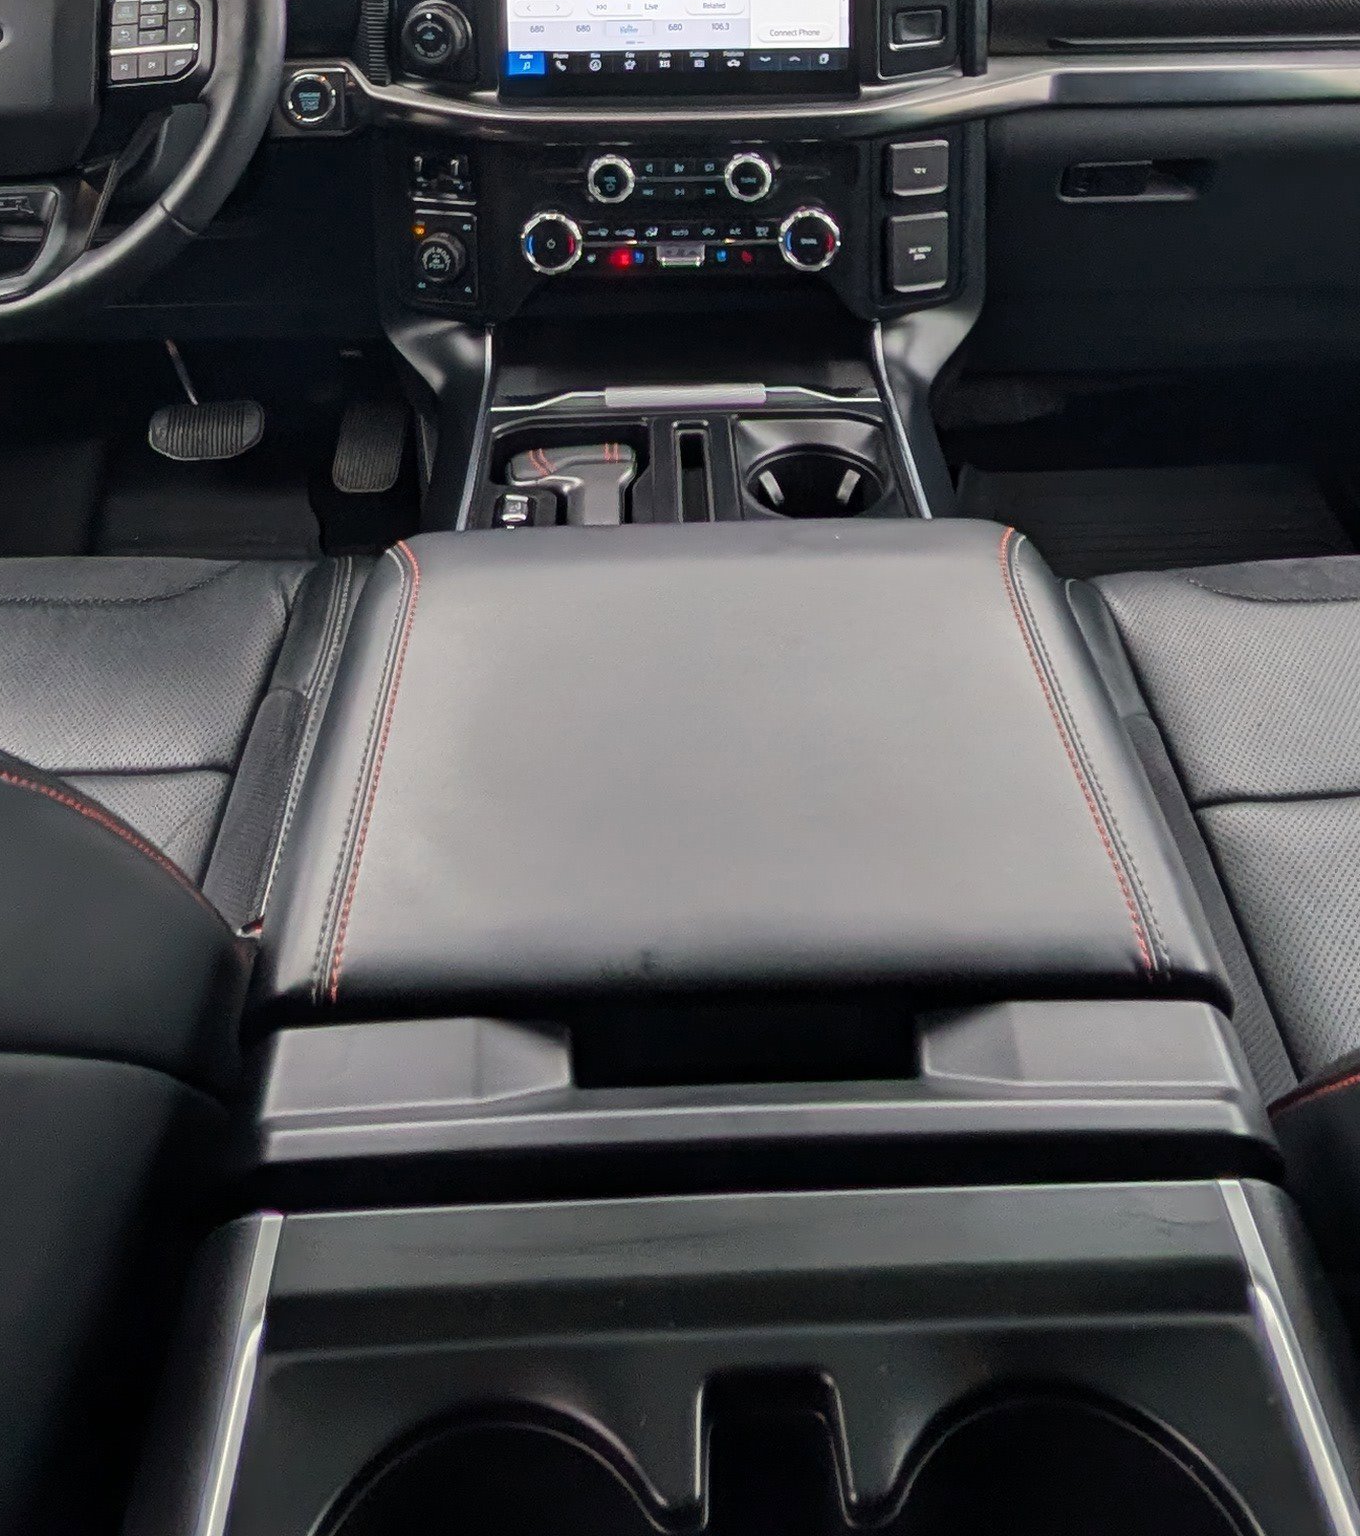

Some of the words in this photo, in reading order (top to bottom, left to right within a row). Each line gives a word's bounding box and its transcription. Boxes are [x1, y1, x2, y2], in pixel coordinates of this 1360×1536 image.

[529, 25, 546, 34] 680
[576, 24, 592, 33] 680
[668, 23, 683, 32] 680
[711, 22, 730, 31] 106.3
[769, 28, 798, 37] Connect
[799, 28, 821, 36] Phone
